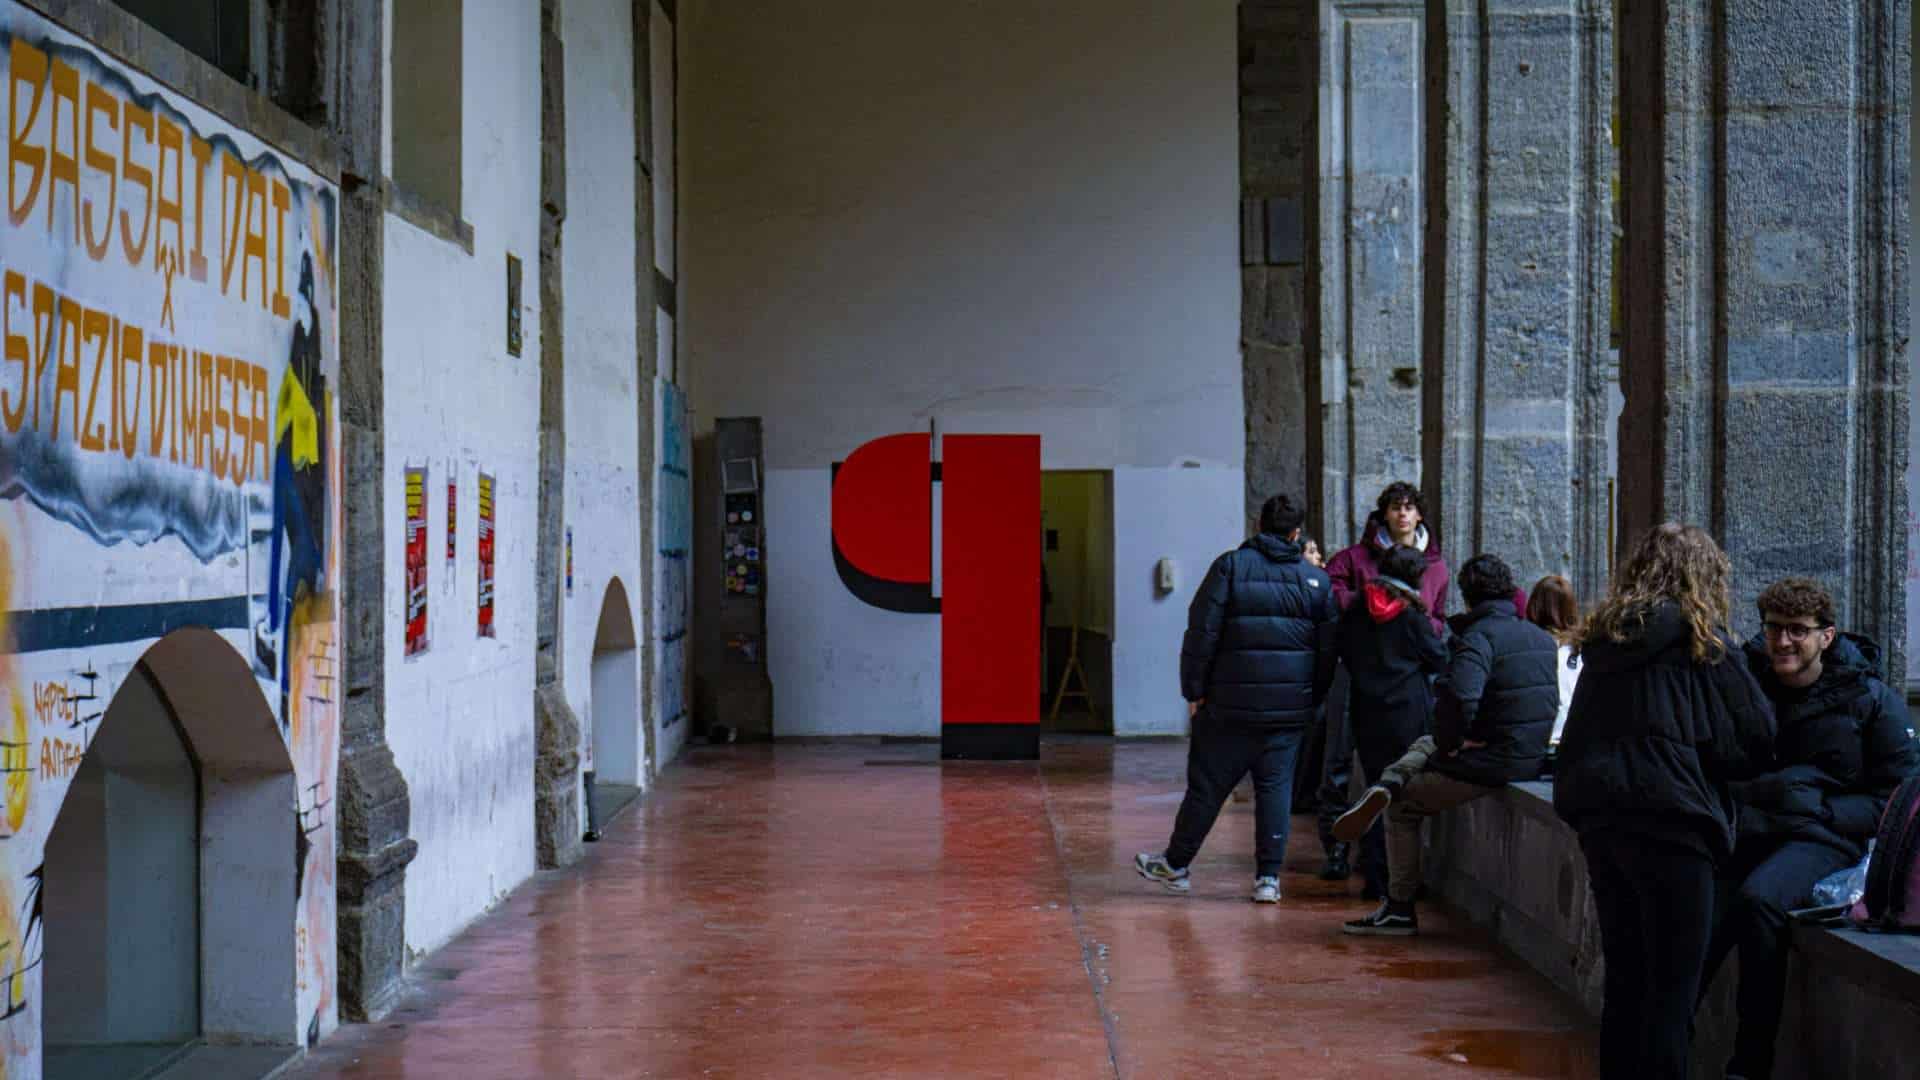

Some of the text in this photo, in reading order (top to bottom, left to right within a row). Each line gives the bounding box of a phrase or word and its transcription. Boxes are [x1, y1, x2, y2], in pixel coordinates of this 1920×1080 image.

[8, 37, 290, 320] BASSAI DAI
[1, 269, 143, 461] SPAZIO
